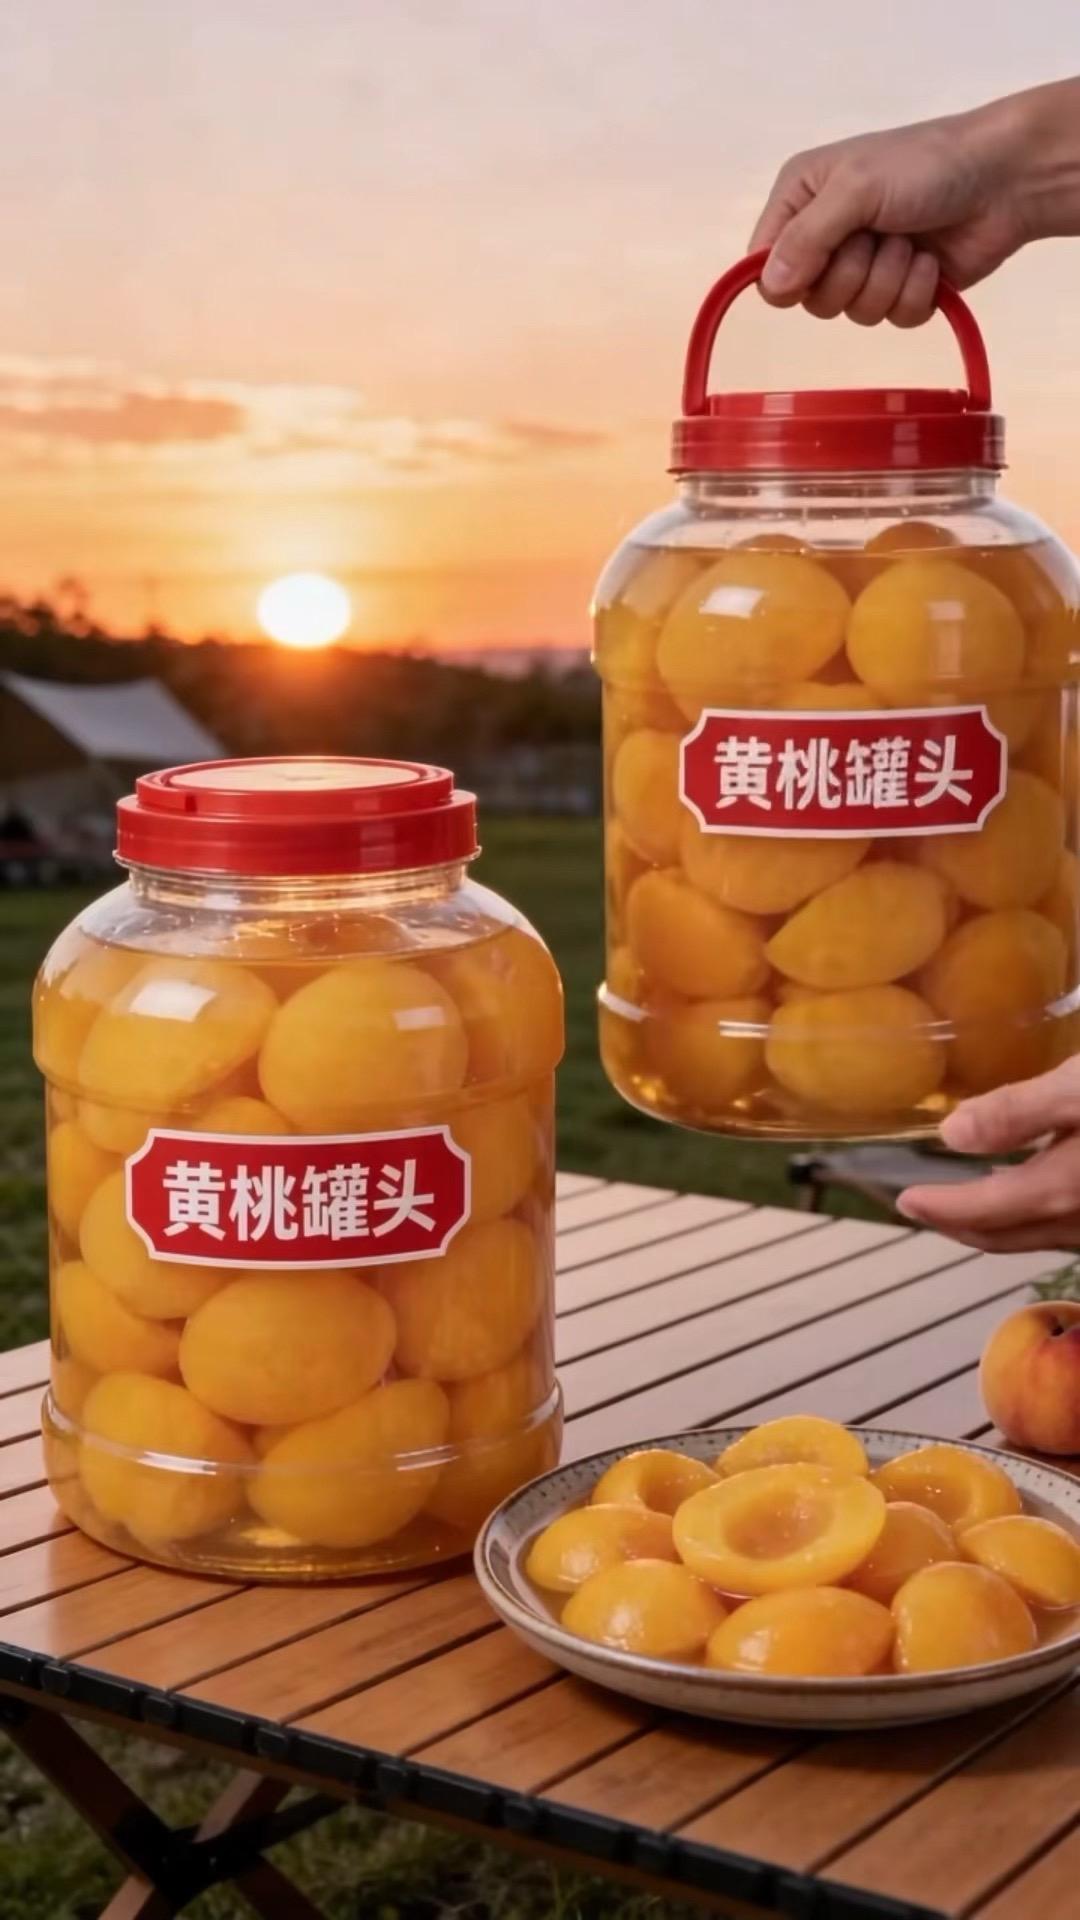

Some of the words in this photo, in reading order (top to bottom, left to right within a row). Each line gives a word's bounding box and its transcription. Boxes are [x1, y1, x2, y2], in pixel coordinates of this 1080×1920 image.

[714, 735, 974, 810] 黄桃罐头
[162, 1159, 436, 1241] 黄桃罐头
